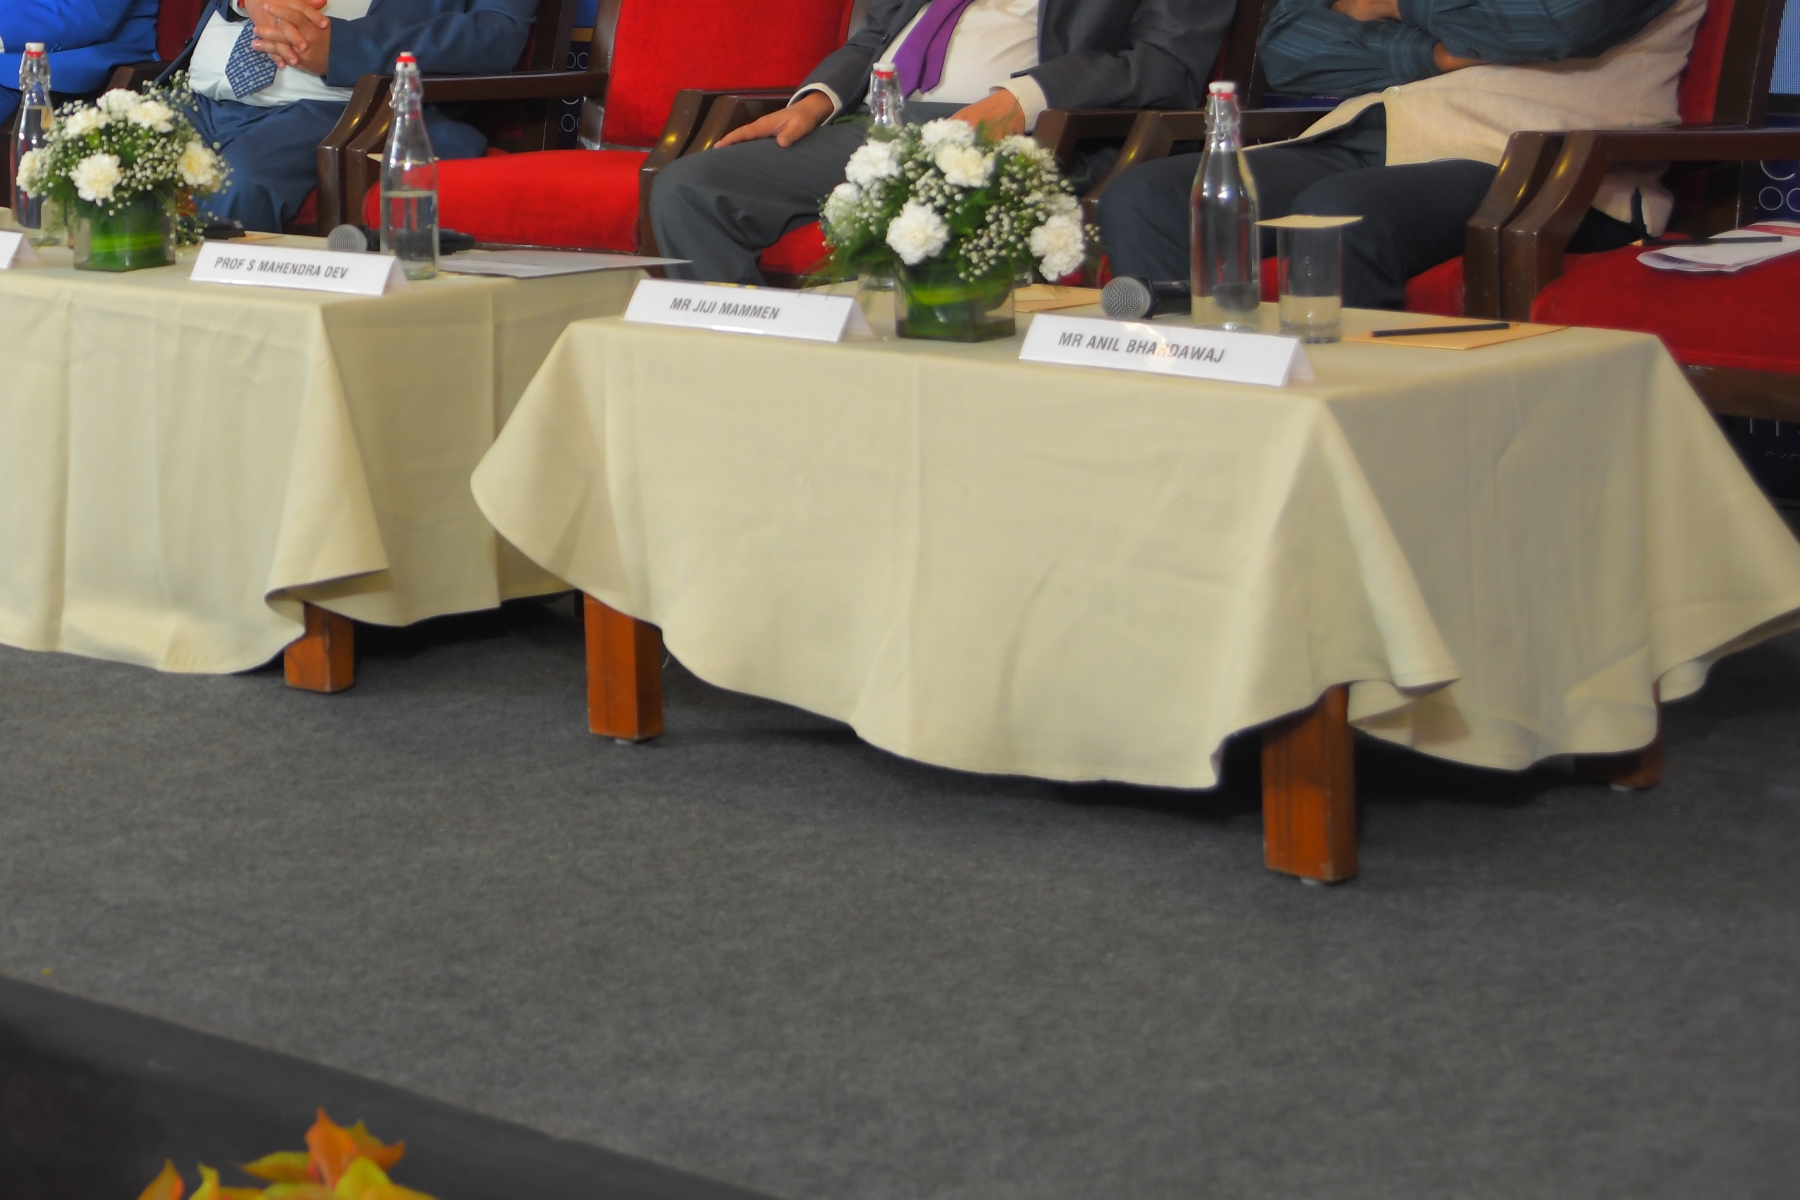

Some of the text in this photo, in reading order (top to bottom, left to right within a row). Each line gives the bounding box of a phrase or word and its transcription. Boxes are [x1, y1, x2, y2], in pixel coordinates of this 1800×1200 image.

[214, 256, 349, 279] PROF S MAHENDRA DEV
[669, 297, 780, 320] MR JIJI MAMMEN
[1057, 331, 1084, 348] MR
[1085, 335, 1120, 352] ANIL
